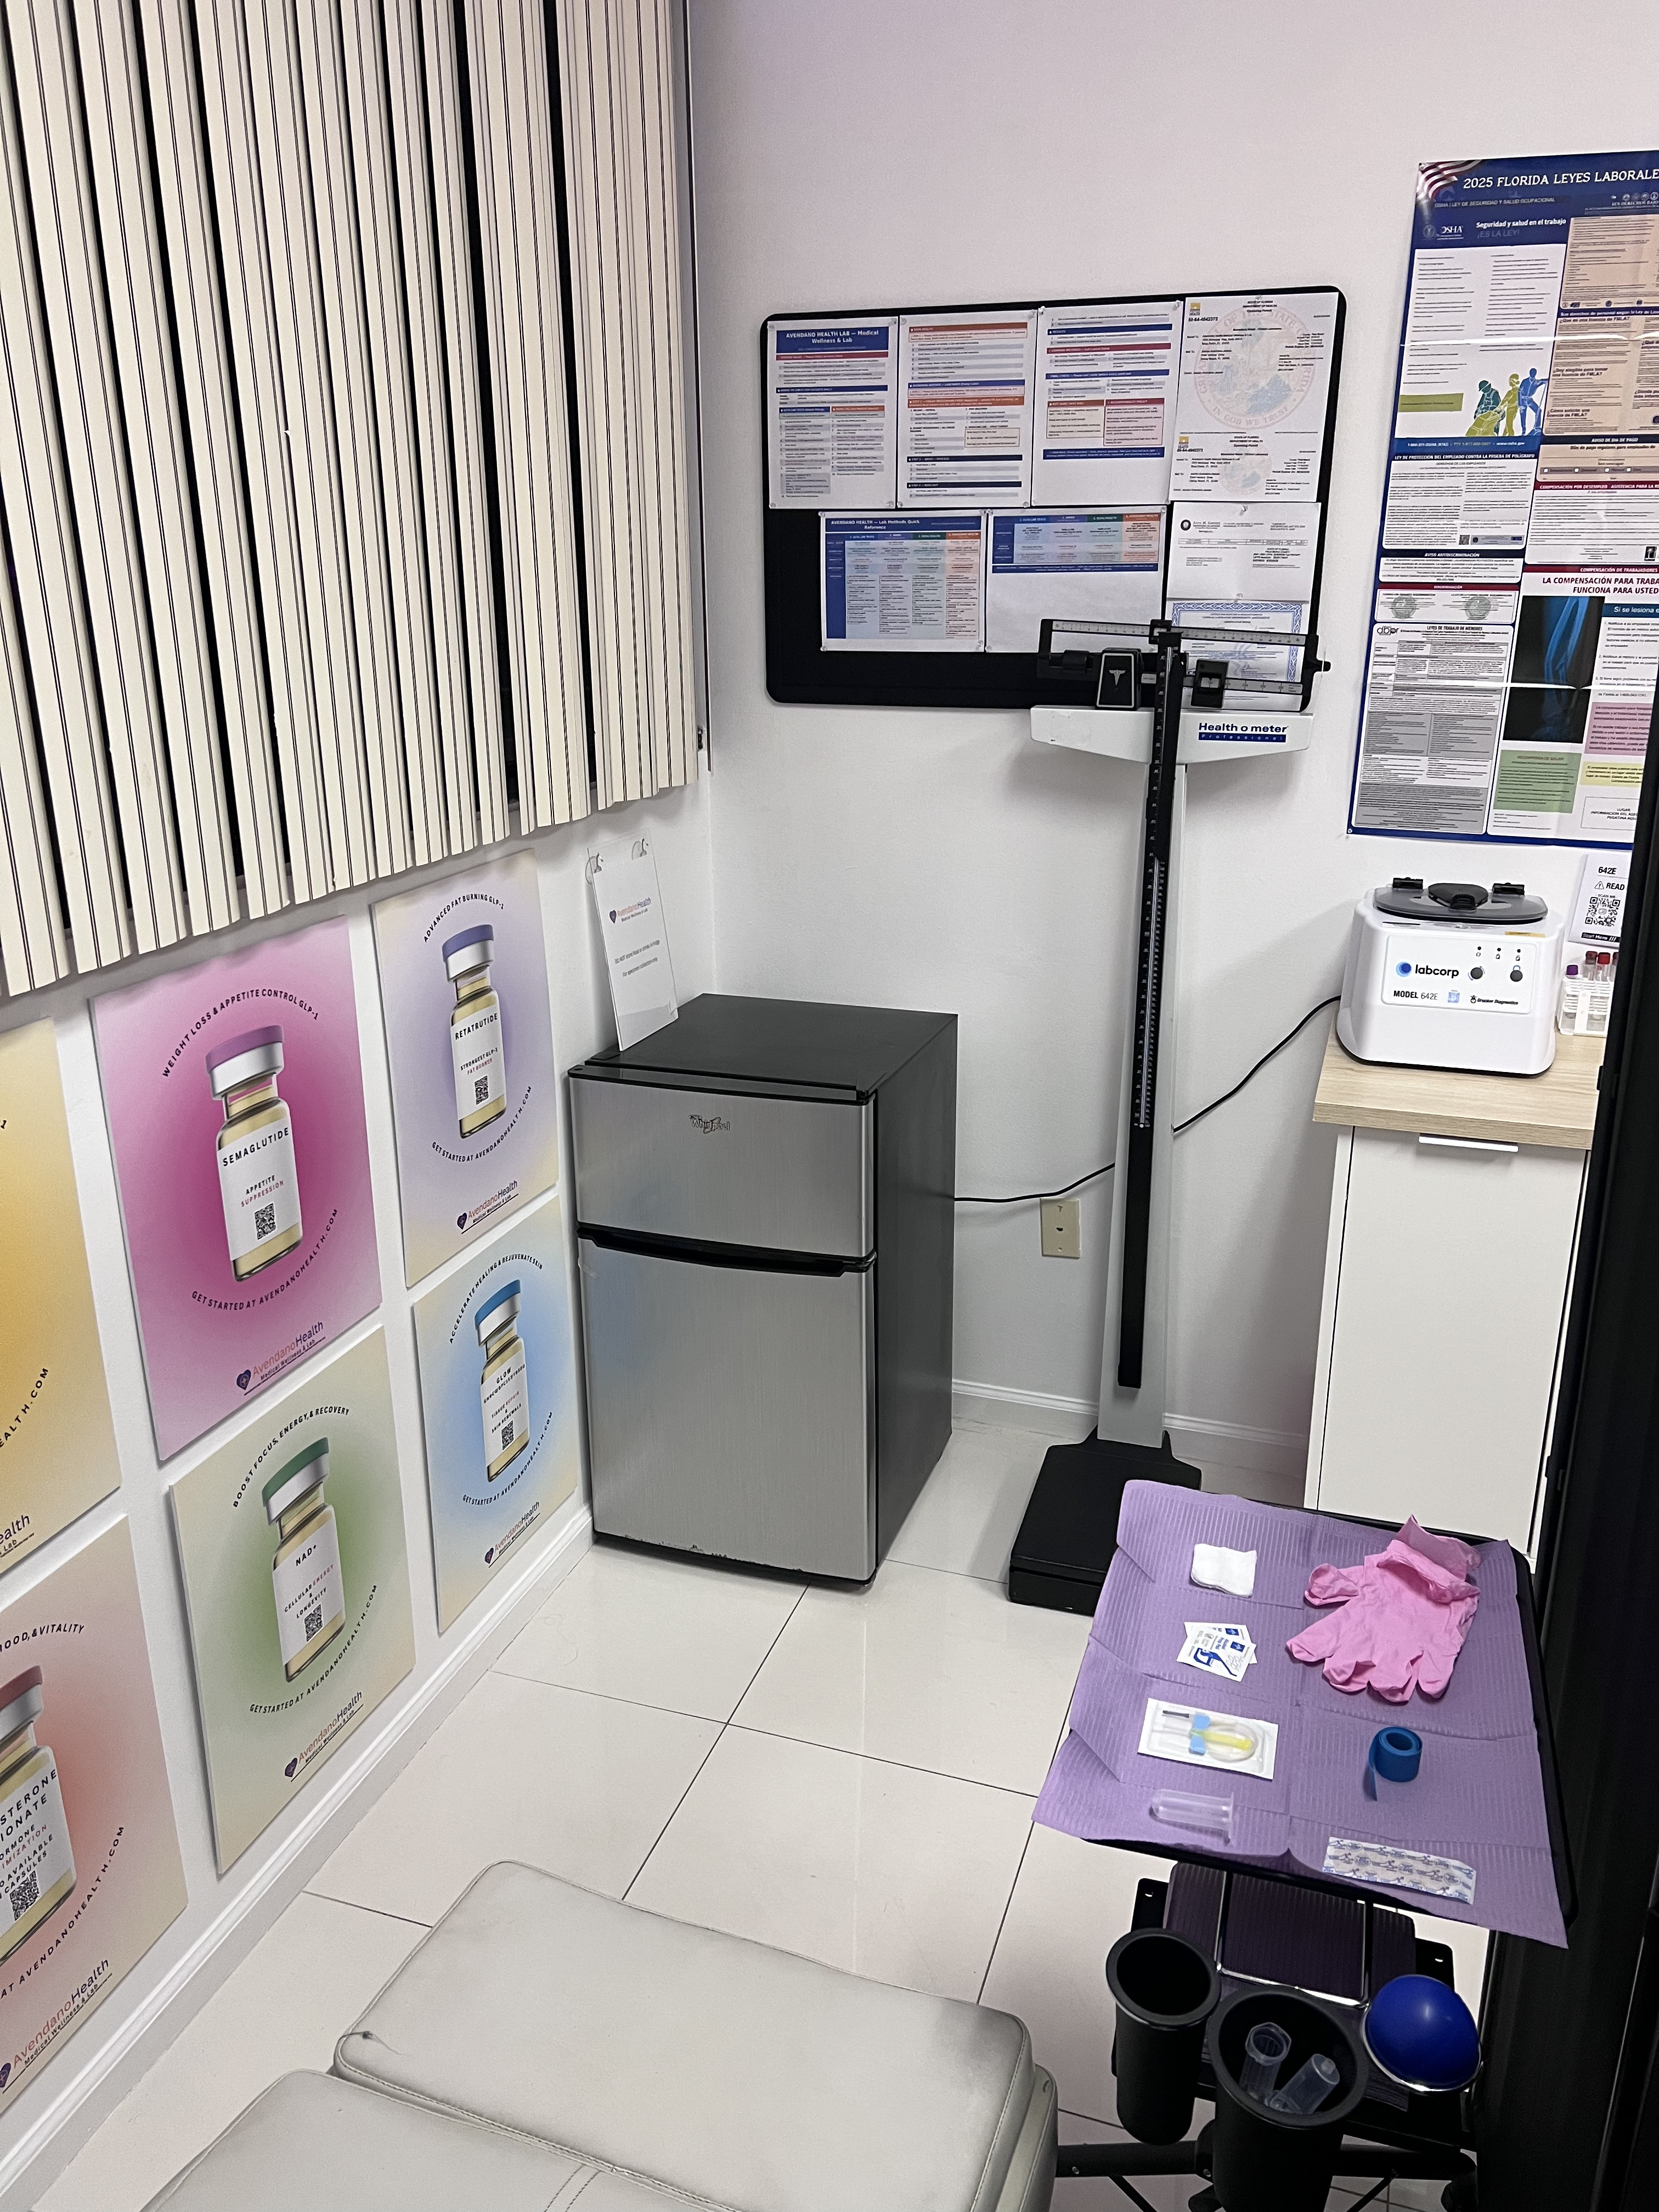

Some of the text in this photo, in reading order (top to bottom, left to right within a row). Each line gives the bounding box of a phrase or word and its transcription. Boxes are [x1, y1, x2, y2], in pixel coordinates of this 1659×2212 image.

[1464, 177, 1493, 189] 2025
[1497, 174, 1549, 187] FLORIDA
[1554, 172, 1590, 184] LEYES
[1476, 221, 1506, 229] Seguridad
[1553, 576, 1612, 585] COMPENSACIÓN
[1199, 723, 1238, 732] Health
[1598, 866, 1617, 875] 642E
[1606, 882, 1625, 891] READ
[424, 893, 504, 943] ADVANCED FAT BURNING GLP-1
[1415, 964, 1459, 978] labcorp
[1393, 990, 1419, 998] MODEL
[162, 1034, 190, 1077] WEIGHT
[190, 1012, 211, 1035] LOSS
[220, 989, 259, 1011] APPETITE
[262, 989, 297, 1004] CONTROL
[299, 1000, 318, 1020] GLP-1
[455, 1013, 498, 1040] RETATRUTIDE
[461, 1047, 498, 1071] STRONGEST GLP-1
[432, 1142, 442, 1153] GET
[442, 1150, 466, 1162] STARTED
[475, 1086, 532, 1160] AVENDANOHEALTH.COM
[690, 1116, 730, 1132] Whirlpool
[223, 1127, 289, 1166] SEMAGLUTIDE
[241, 1180, 284, 1207] SUPPRESSION
[246, 1175, 275, 1195] APPETITE
[468, 1180, 517, 1220] AvendanoHealth
[192, 1209, 338, 1311] GET STARTED AT AVENDANOHEALTH.COM
[449, 1287, 475, 1344] ACCELERATE
[476, 1262, 498, 1289] HEALING
[502, 1254, 533, 1263] REJUVENATE
[533, 1258, 543, 1270] SKIN
[252, 1321, 324, 1379] AvendanoHealth
[261, 1364, 280, 1381] Medical
[280, 1348, 302, 1367] Wellness
[306, 1339, 315, 1348] Lab
[496, 1367, 511, 1384] GLOW
[492, 1403, 505, 1419] TISSUE
[492, 1422, 501, 1433] SKIN
[233, 1469, 254, 1508] BOOST
[253, 1438, 279, 1469] FOCUS,
[279, 1412, 309, 1438] ENERGY,
[315, 1406, 349, 1416] RECOVERY
[462, 1412, 552, 1505] GET STARTED AT AVENDANOHEALTH.COM
[3, 1538, 17, 1551] Lab
[494, 1502, 540, 1553] AvendanoHealth
[296, 1545, 317, 1567] NAD+
[284, 1565, 334, 1612] CELLULAR ENERGY
[296, 1587, 326, 1618] LONGEVITY
[0, 1623, 84, 1652] OOD, & VITALITY
[250, 1585, 377, 1713] GET STARTED AT AVENDANOHEALTH.COM
[298, 1691, 362, 1763] AvendanoHealth
[306, 1743, 323, 1763] Medical
[323, 1723, 342, 1743] Wellness
[346, 1709, 354, 1719] Lab
[4, 1850, 47, 1894] CAPSULES
[7, 1834, 53, 1881] AVAILABLE
[1, 1826, 125, 1999] AT AVENDANOHEALTH.COM
[14, 1959, 109, 2068] AvendanoHealth
[24, 2035, 51, 2066] Medical
[52, 2003, 80, 2036] Wellness
[87, 1983, 99, 1997] Lab
